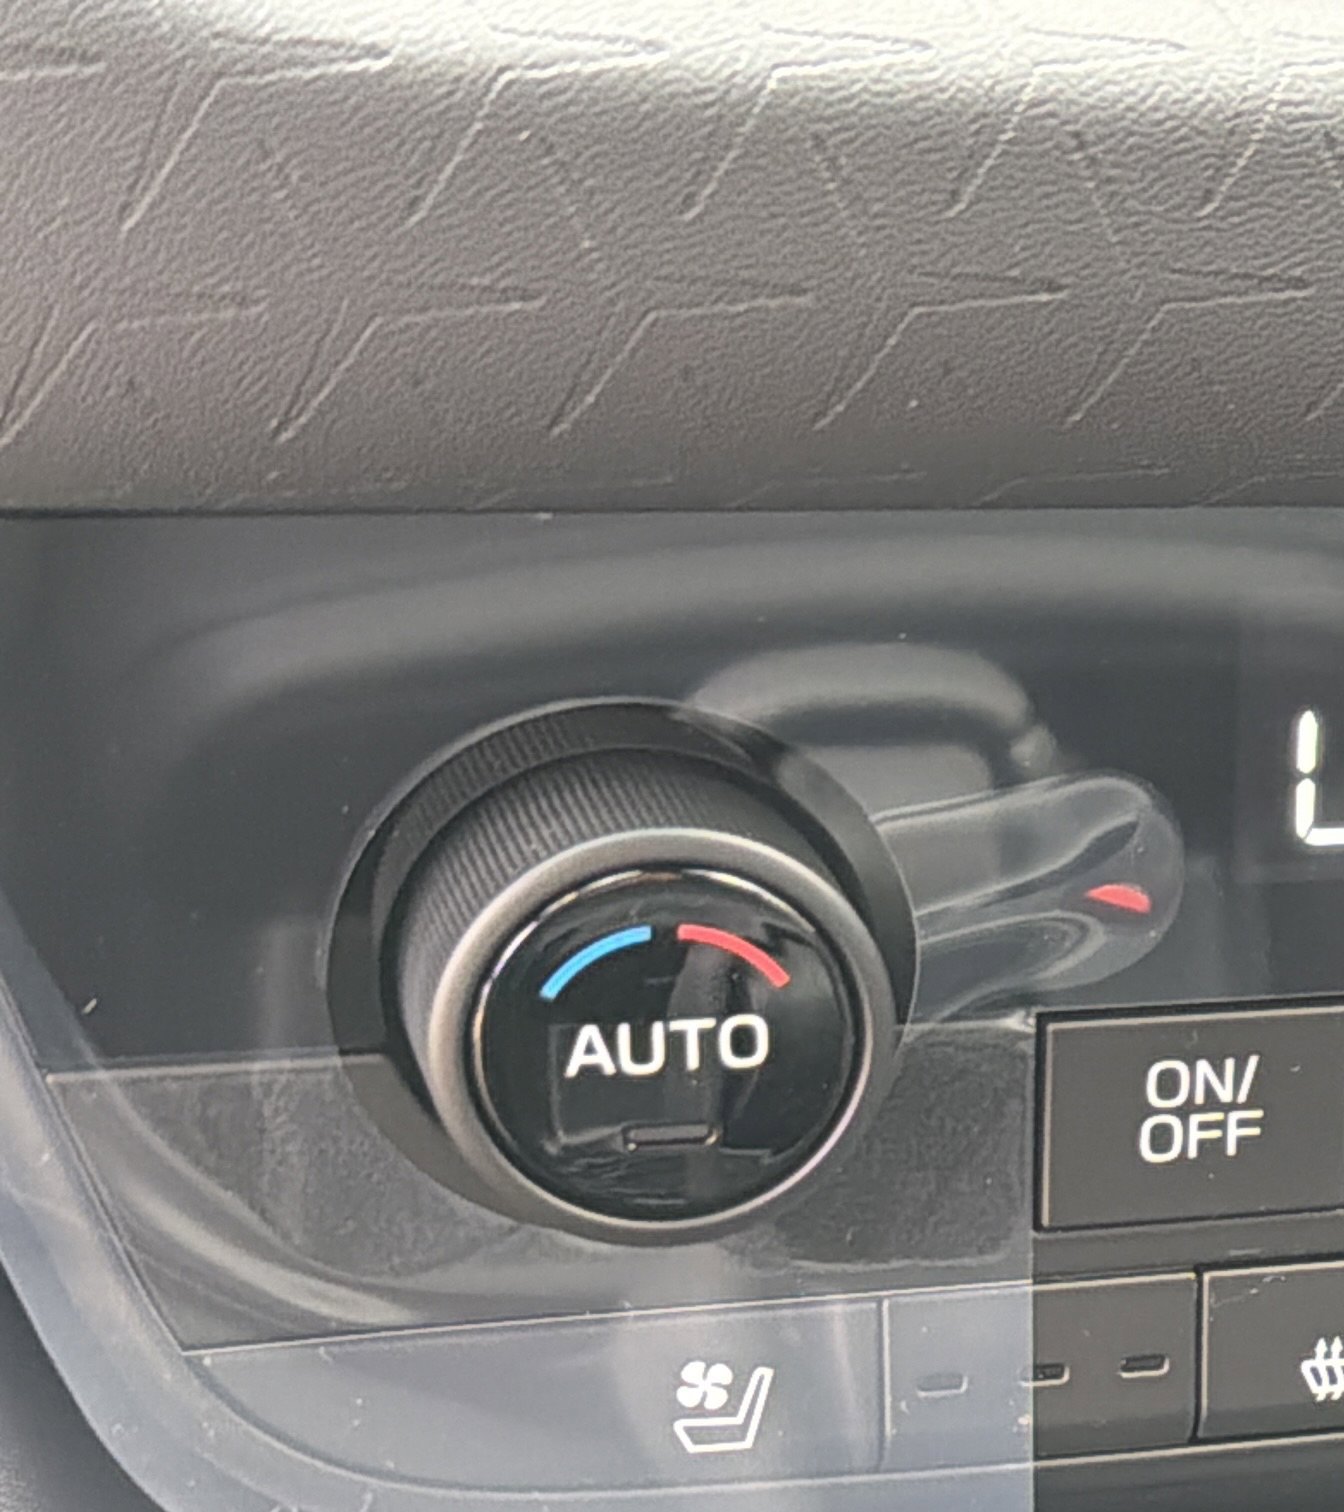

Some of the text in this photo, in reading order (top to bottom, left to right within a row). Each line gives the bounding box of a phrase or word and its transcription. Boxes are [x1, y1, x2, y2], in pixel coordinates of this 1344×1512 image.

[564, 1014, 770, 1080] AUTO
[1145, 1053, 1259, 1110] ON/
[1138, 1109, 1263, 1163] OFF
